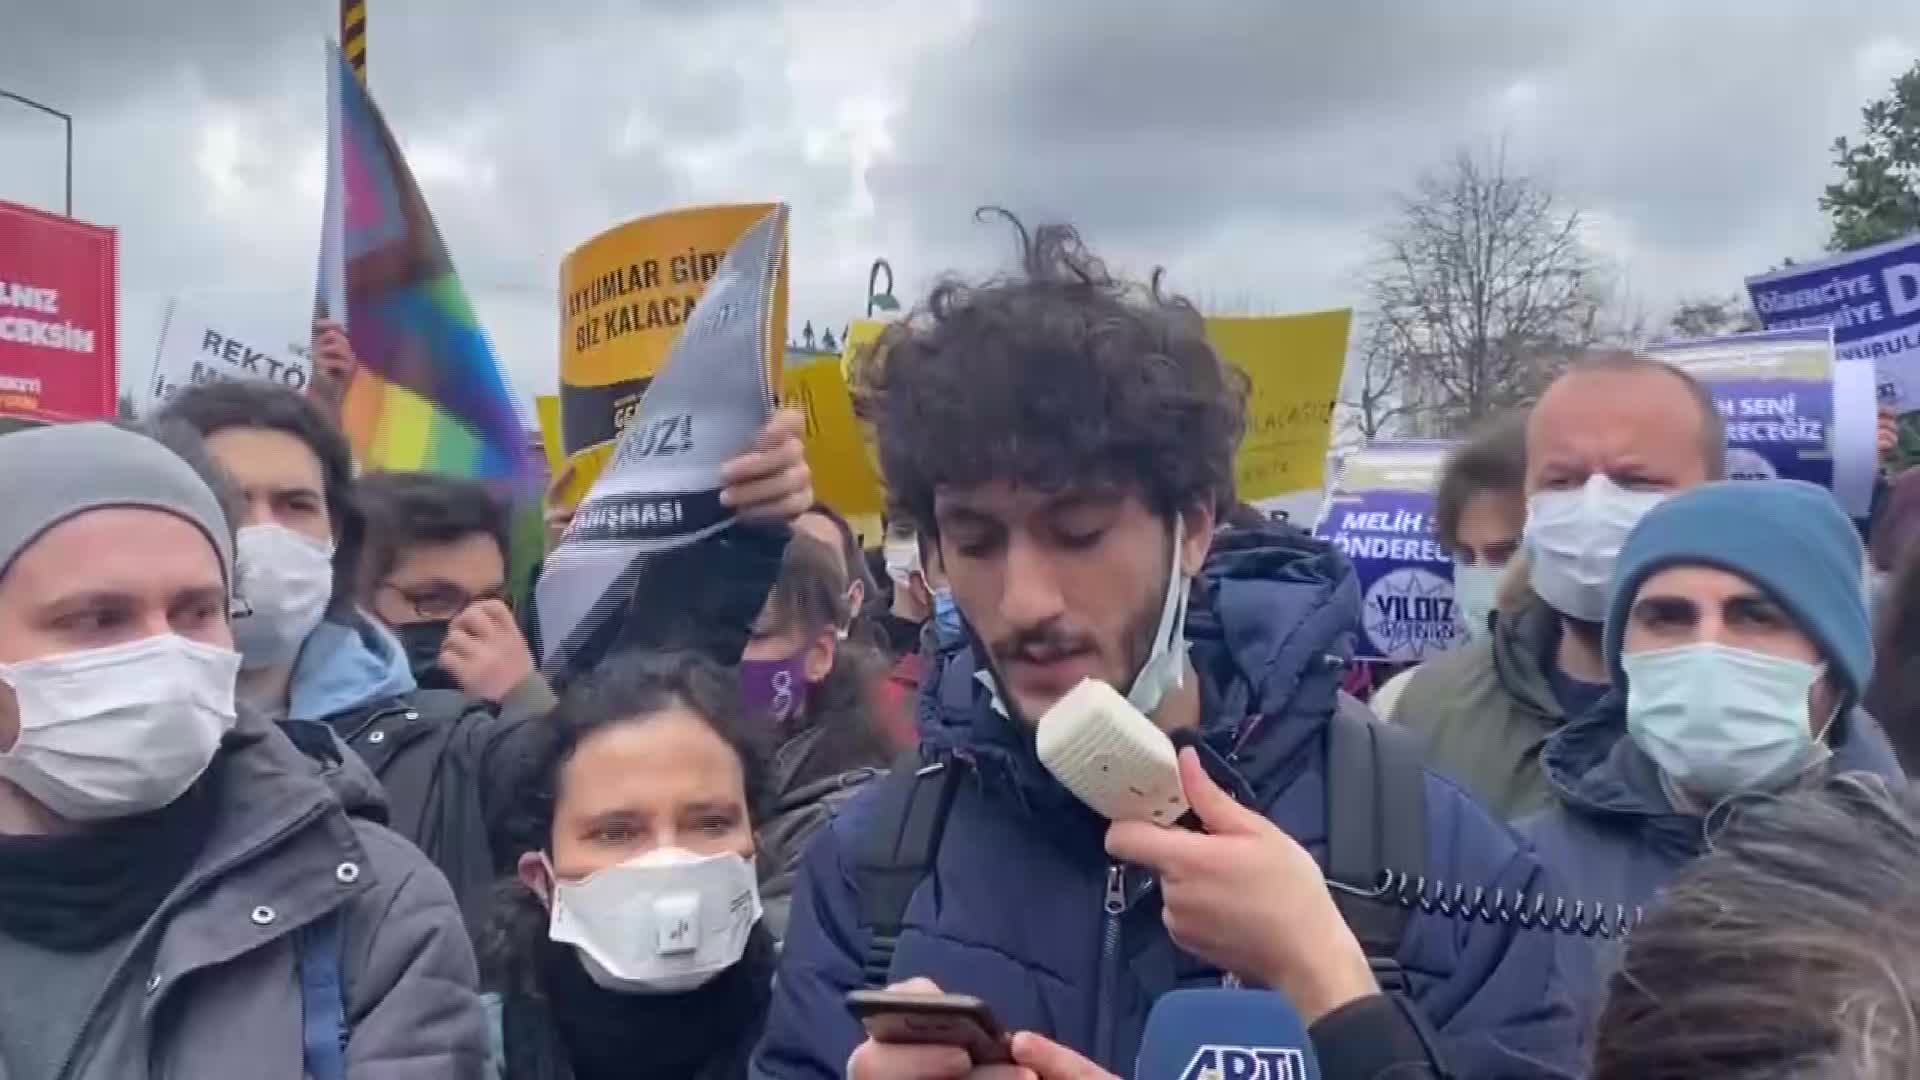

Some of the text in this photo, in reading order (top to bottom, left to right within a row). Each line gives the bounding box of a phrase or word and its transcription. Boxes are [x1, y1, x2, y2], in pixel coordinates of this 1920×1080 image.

[671, 247, 727, 284] GİD
[576, 313, 600, 352] BİZ
[202, 327, 307, 389] REKTÖ
[1341, 507, 1424, 534] MELİH
[1375, 594, 1455, 622] YILDIZ
